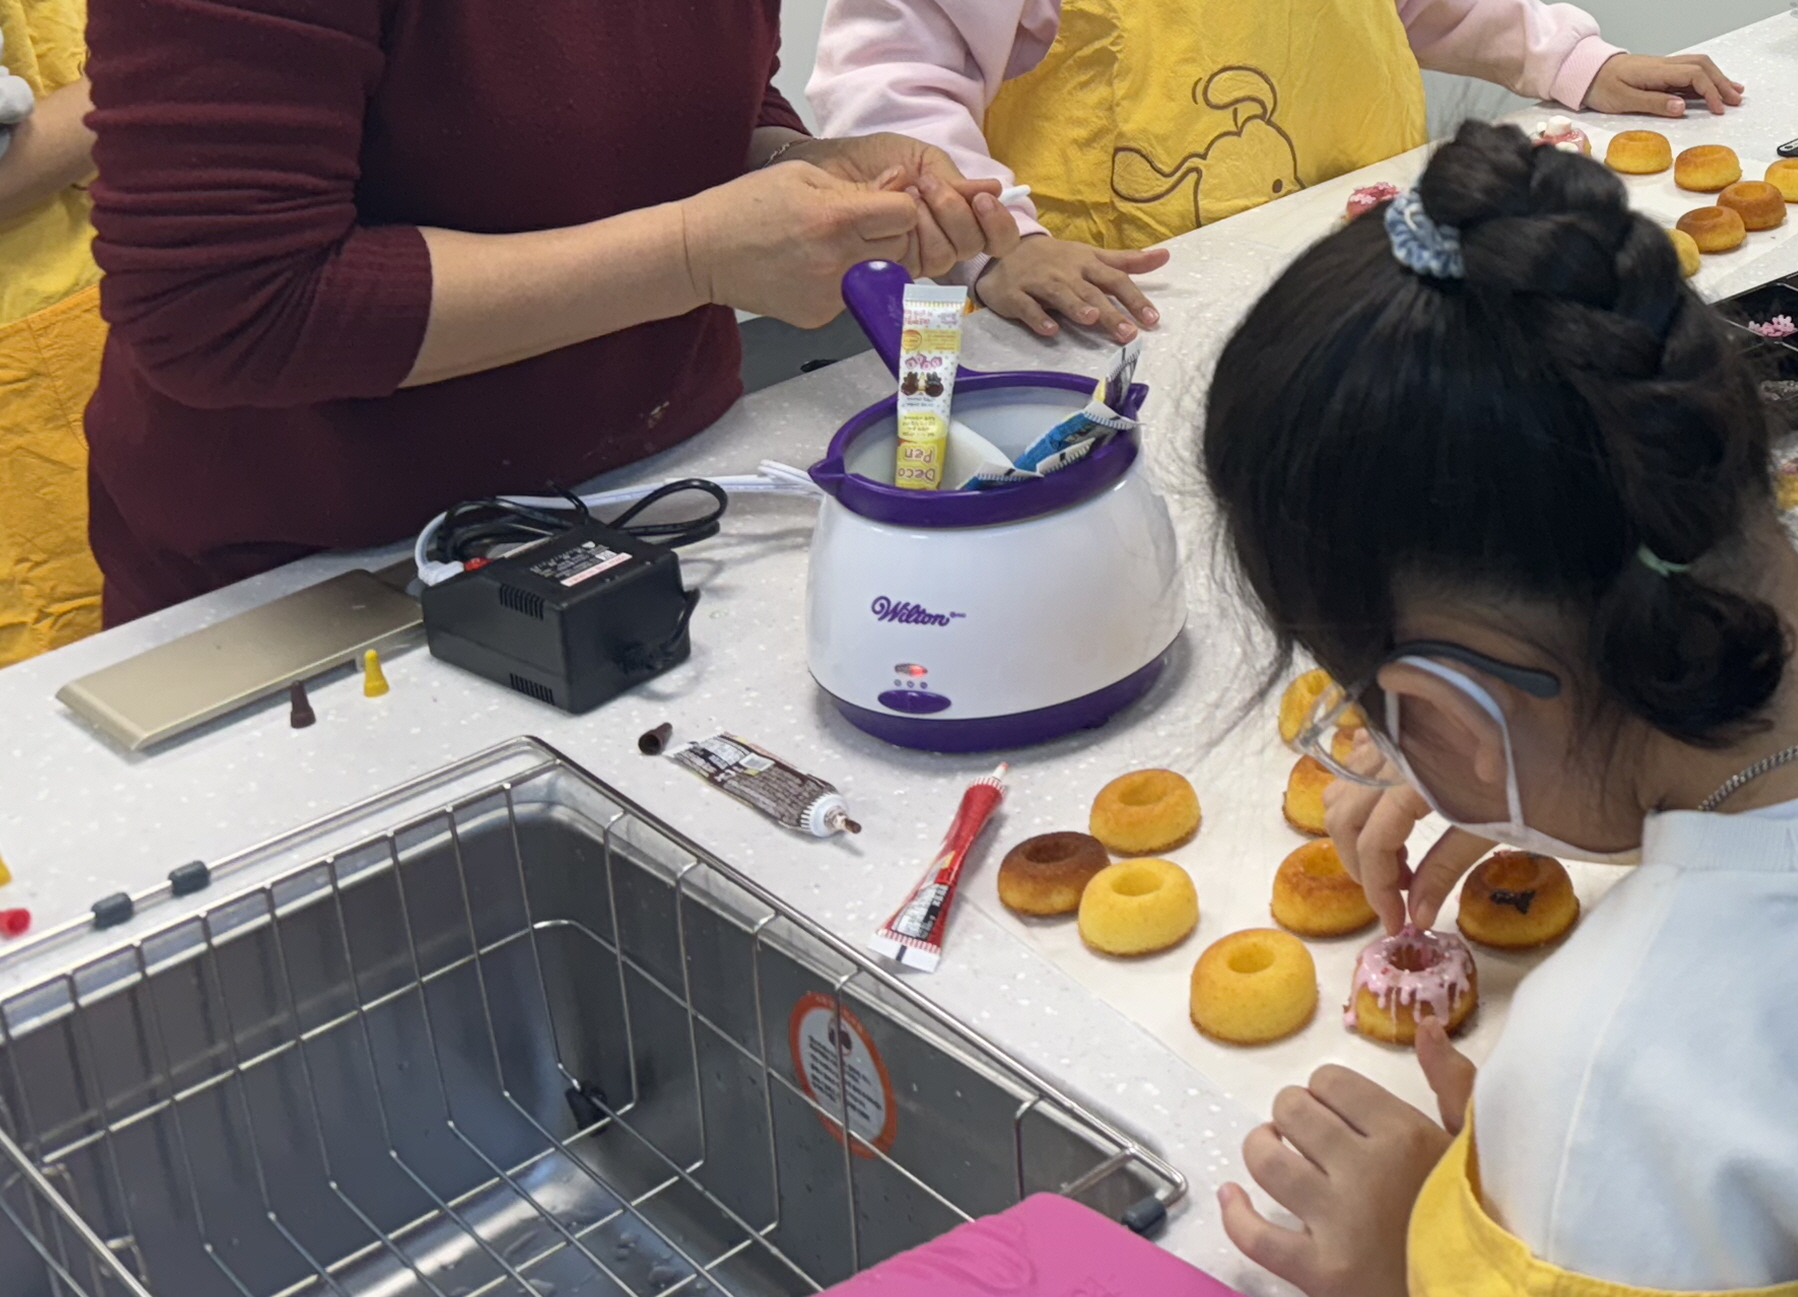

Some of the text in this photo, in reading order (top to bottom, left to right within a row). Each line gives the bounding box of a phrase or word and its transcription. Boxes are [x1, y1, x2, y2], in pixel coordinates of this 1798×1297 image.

[904, 445, 934, 463] Pen
[898, 466, 937, 482] Deco
[871, 595, 950, 627] Wilton
